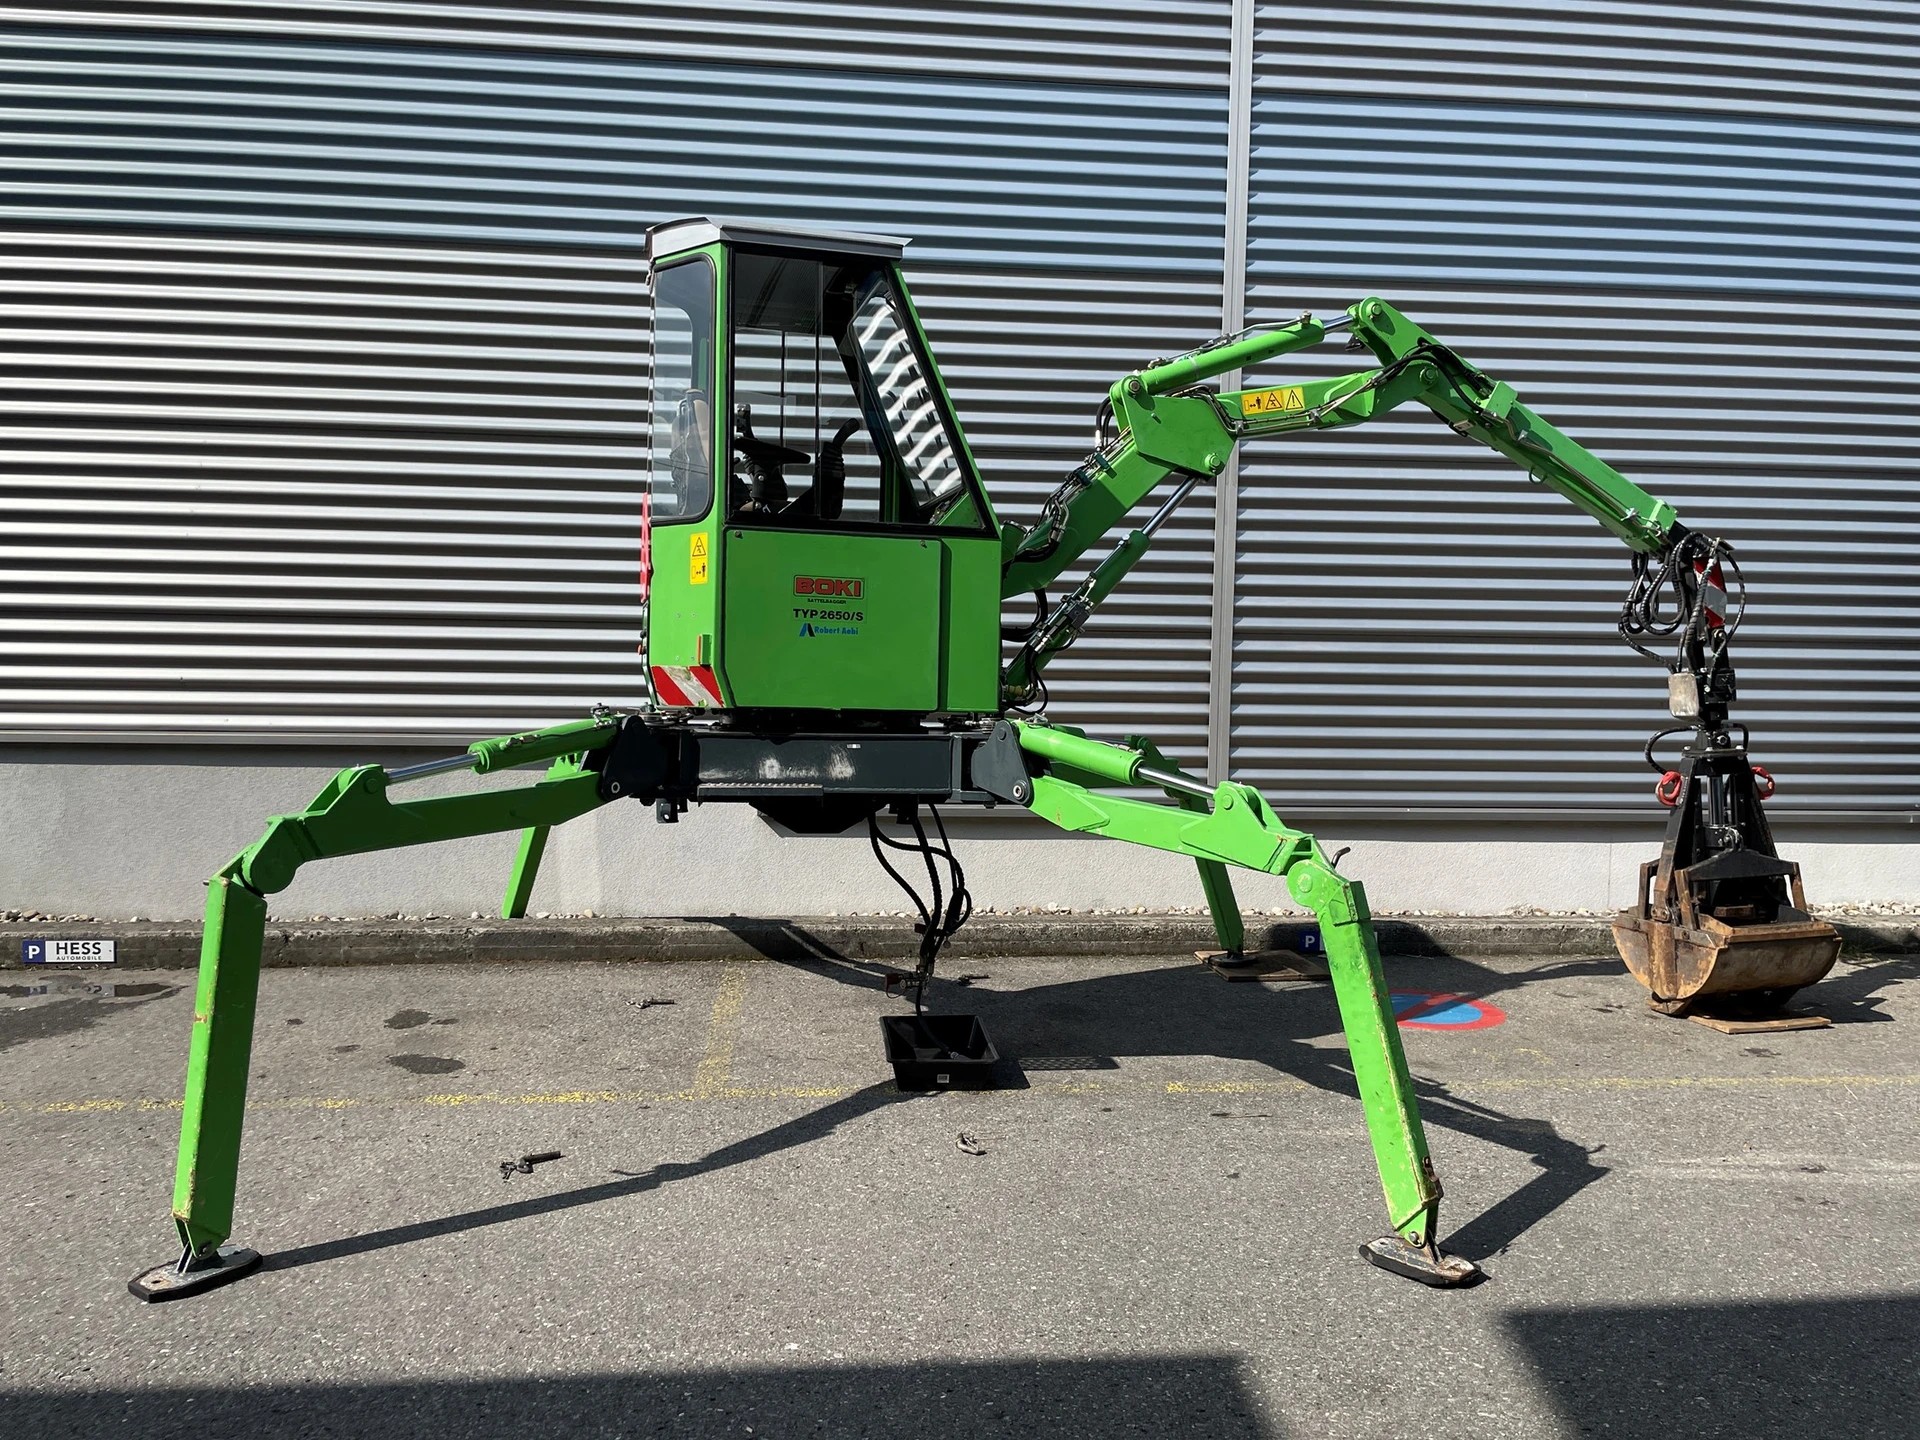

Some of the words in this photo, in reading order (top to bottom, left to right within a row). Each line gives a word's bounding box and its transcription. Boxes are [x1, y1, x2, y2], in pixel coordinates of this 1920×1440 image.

[796, 577, 861, 597] BOKI
[793, 609, 818, 618] TYP
[820, 611, 863, 621] 2650/S
[814, 626, 840, 635] Robert
[842, 627, 859, 635] Aebi
[1305, 935, 1315, 948] P
[28, 945, 40, 959] P
[56, 942, 101, 955] HESS
